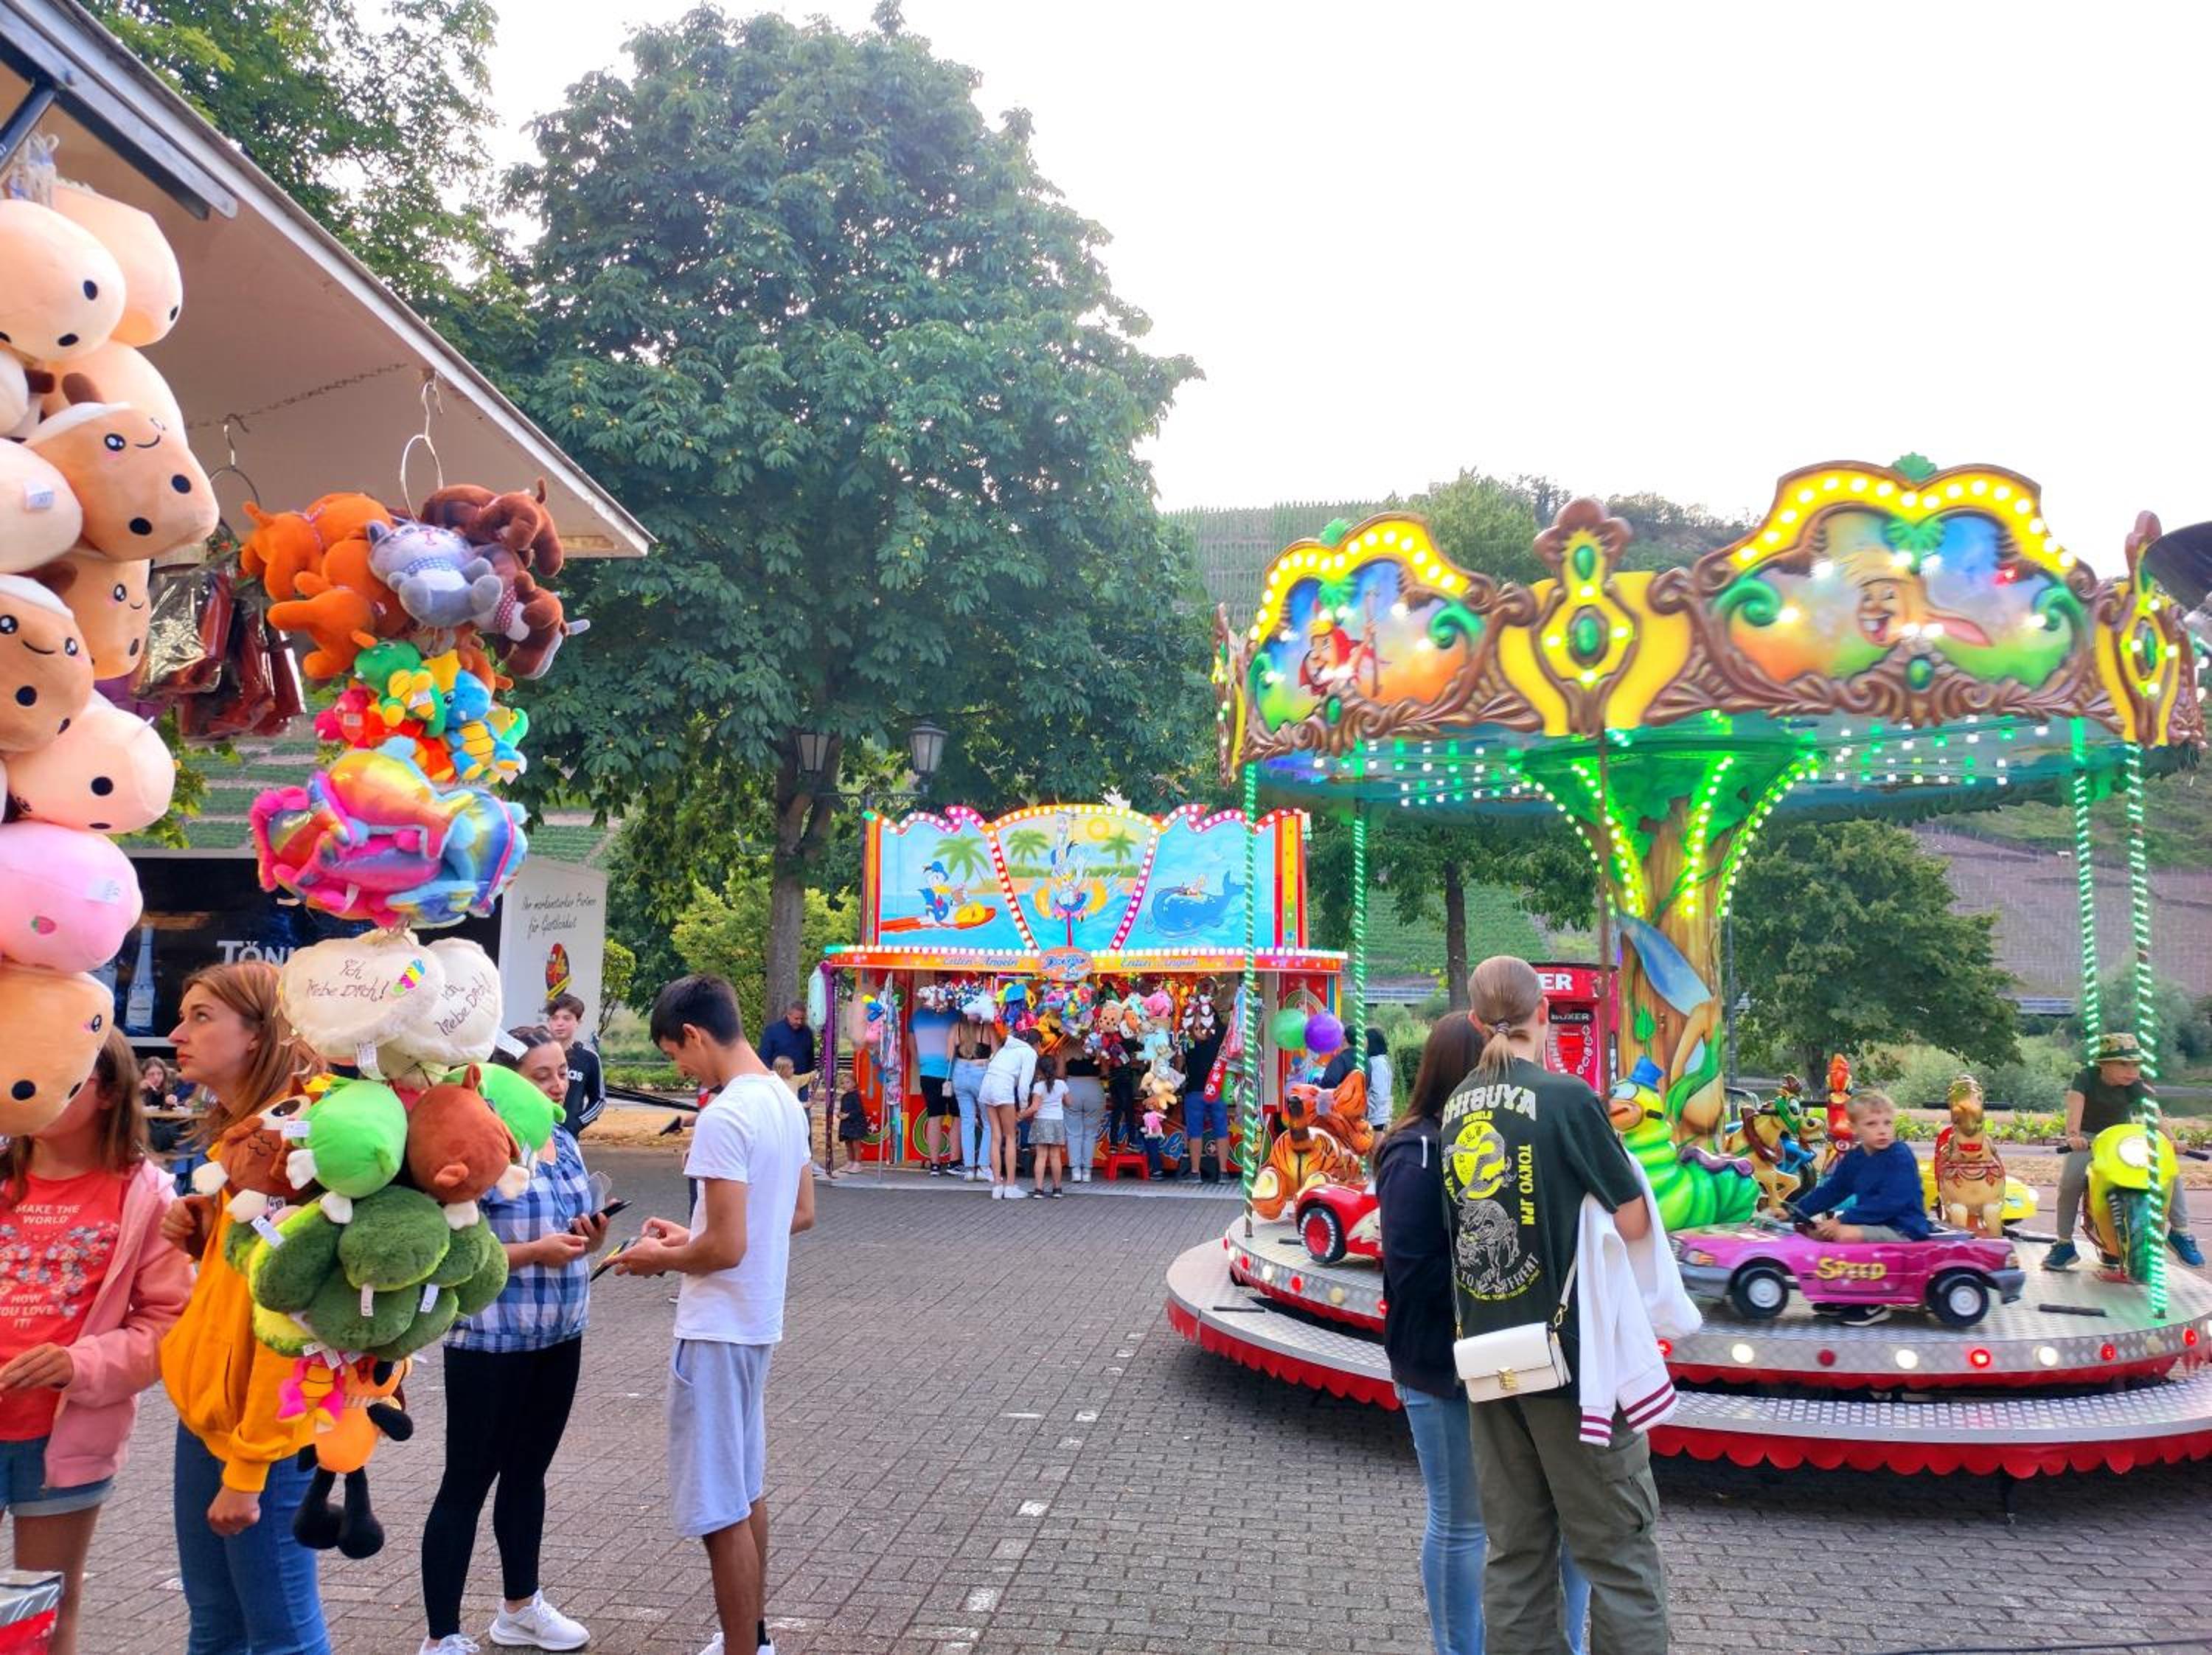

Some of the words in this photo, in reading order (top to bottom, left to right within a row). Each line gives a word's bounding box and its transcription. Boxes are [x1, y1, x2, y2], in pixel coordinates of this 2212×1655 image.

[1537, 973, 1573, 991] ER
[568, 1070, 583, 1082] as
[1518, 1145, 1534, 1194] TOKYO
[15, 1204, 52, 1213] MAKE
[57, 1204, 81, 1214] THE
[1520, 1198, 1535, 1226] JPN
[23, 1215, 69, 1224] WORLD
[12, 1294, 42, 1303] HOW
[0, 1307, 19, 1316] OU
[23, 1305, 55, 1315] LOVE
